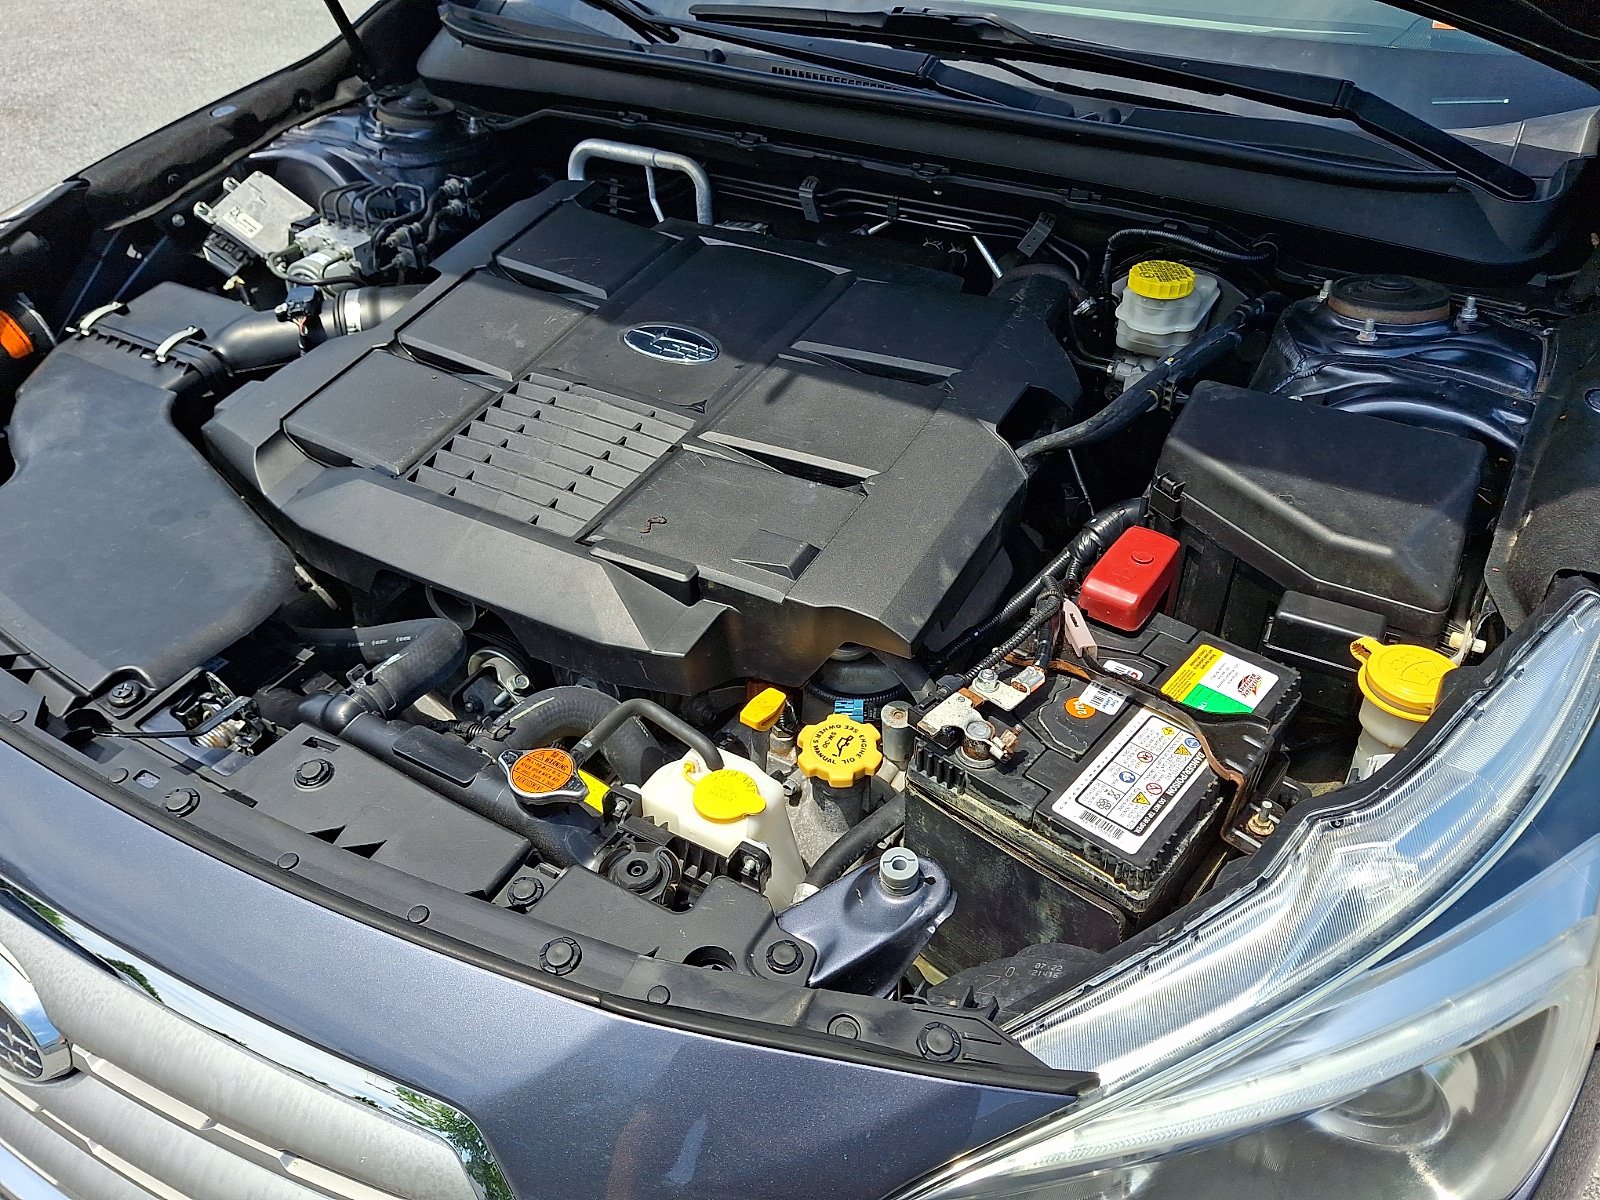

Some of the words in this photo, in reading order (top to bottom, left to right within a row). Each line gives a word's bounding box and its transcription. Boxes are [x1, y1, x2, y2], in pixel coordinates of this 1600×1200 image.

[844, 724, 859, 734] SEE
[822, 731, 837, 749] 5W-30
[855, 734, 868, 759] ENGINE
[544, 757, 569, 771] WARNING
[812, 745, 837, 765] MANUAL
[841, 757, 856, 765] OIL
[1165, 751, 1206, 796] DANGER/POISON
